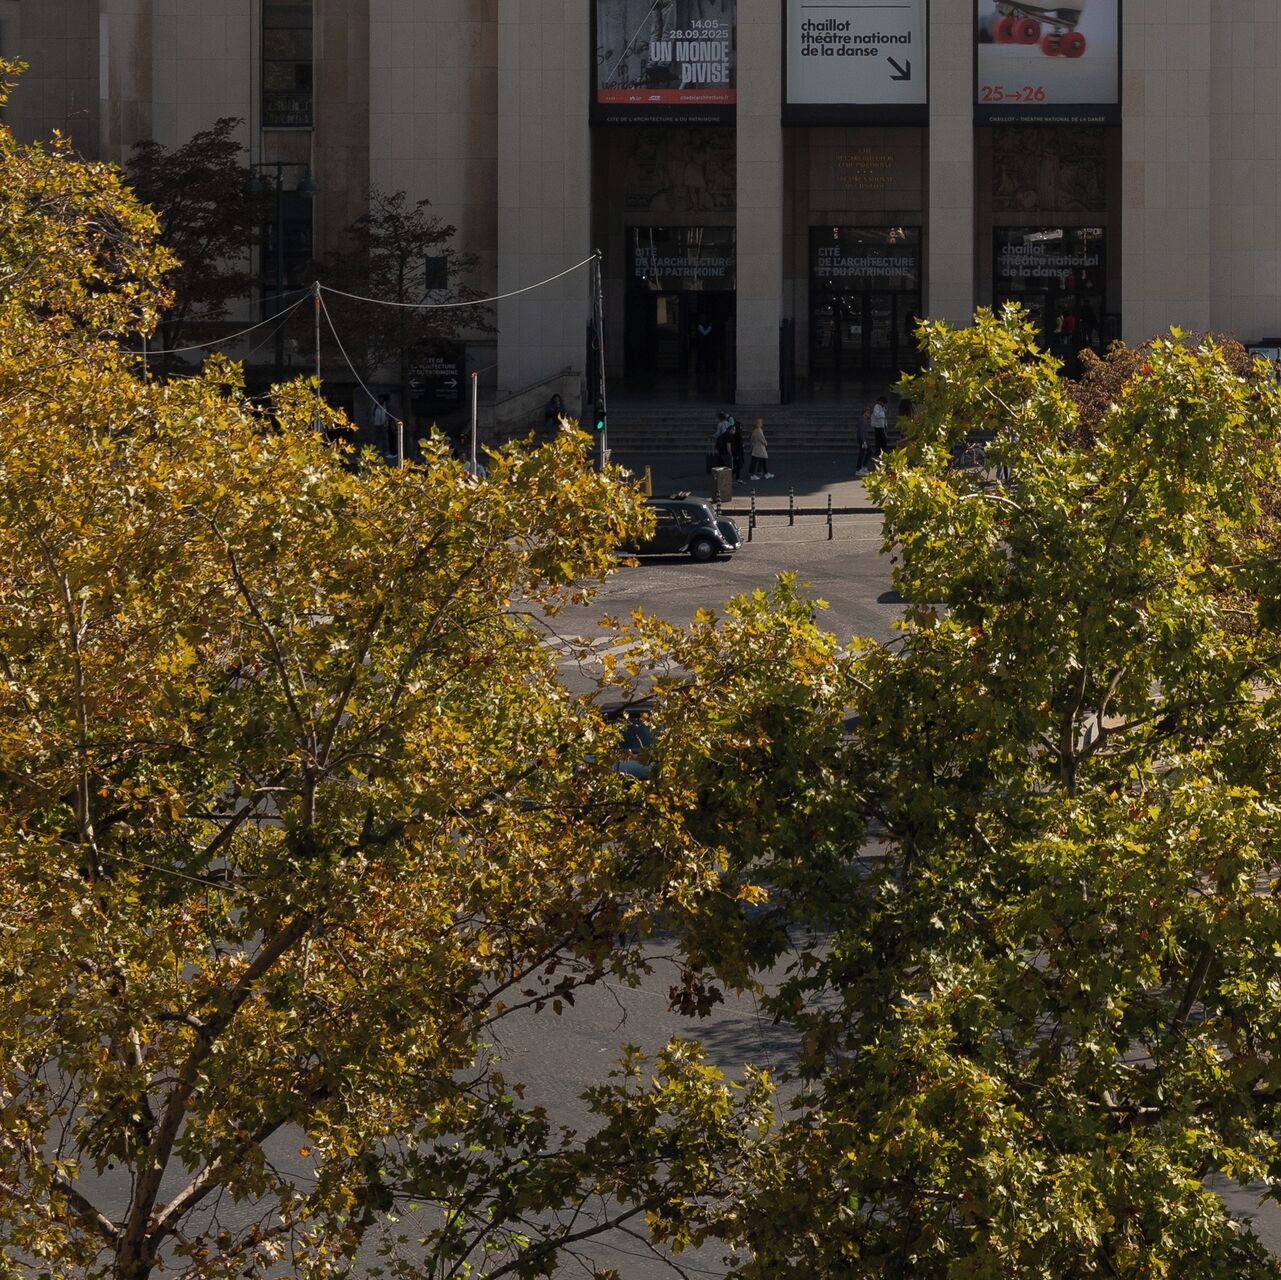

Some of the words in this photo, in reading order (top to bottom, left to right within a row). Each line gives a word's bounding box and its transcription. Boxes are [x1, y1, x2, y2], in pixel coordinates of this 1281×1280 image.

[801, 19, 850, 32] chaillot
[670, 30, 729, 39] 28.09.2025
[801, 31, 852, 44] théâtre
[854, 31, 911, 44] national
[651, 41, 672, 62] UN
[676, 41, 729, 62] MONDE
[801, 44, 819, 57] de
[821, 44, 834, 57] la
[837, 44, 878, 57] danse
[1002, 243, 1045, 254] chaillot
[818, 257, 831, 267] DE
[833, 257, 915, 267] L'ARCHITECTURE
[665, 267, 726, 277] PATRIMOINE
[833, 267, 846, 277] DU
[1002, 266, 1017, 277] de
[1019, 266, 1031, 277] la
[1032, 266, 1069, 277] danse
